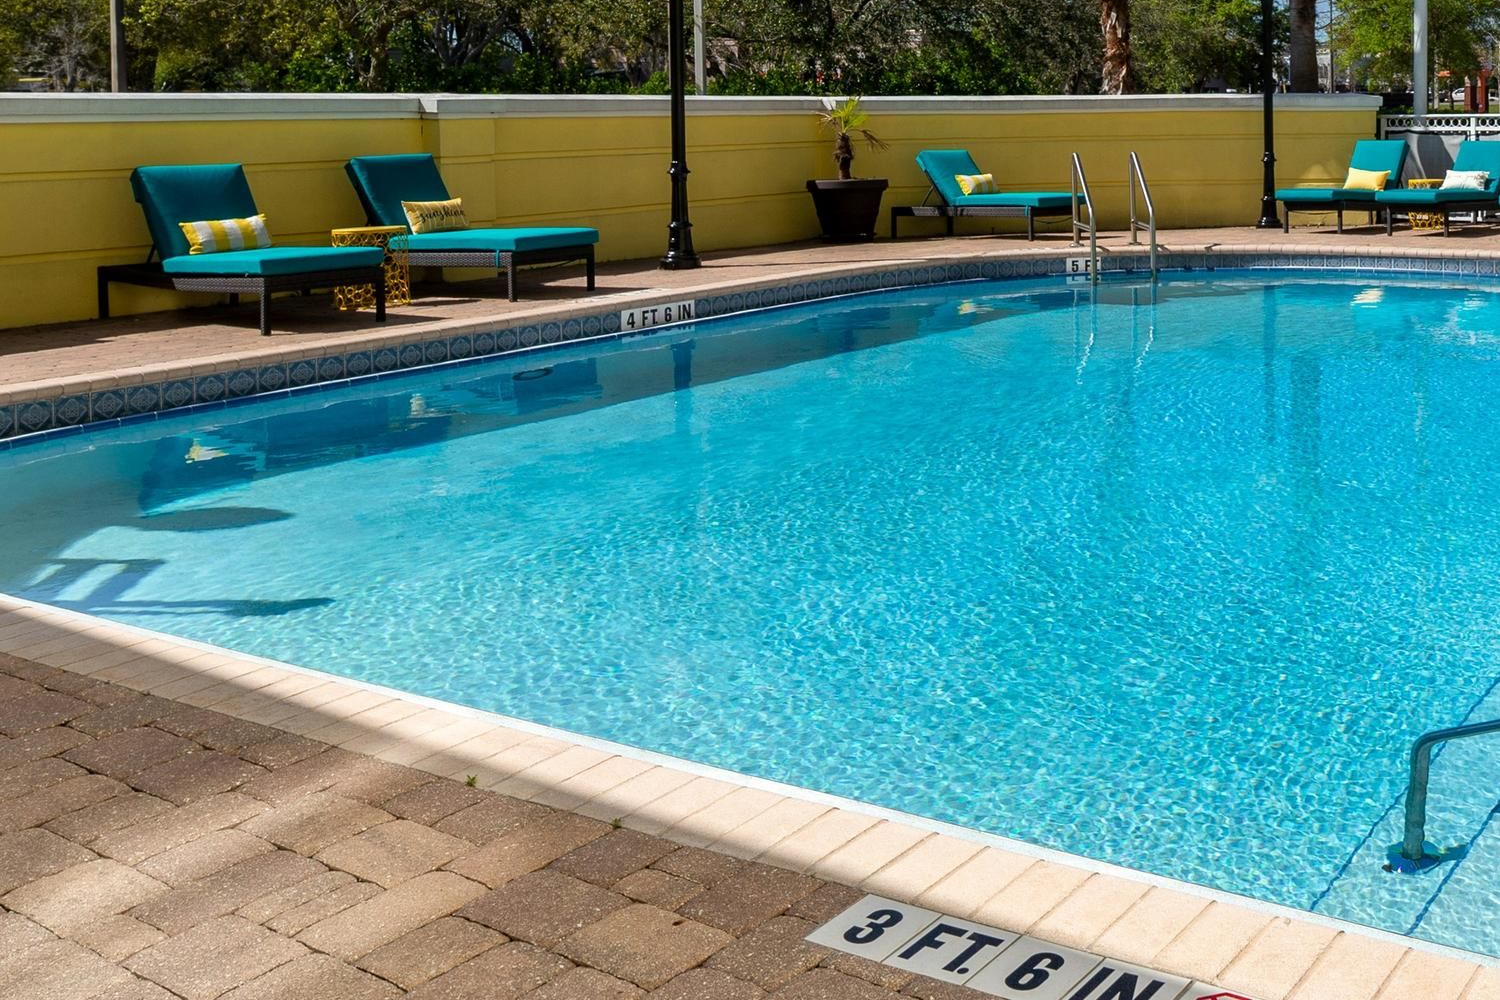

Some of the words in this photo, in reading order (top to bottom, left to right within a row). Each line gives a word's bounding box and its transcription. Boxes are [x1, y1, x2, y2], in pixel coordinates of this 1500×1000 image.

[1072, 260, 1079, 272] 5
[627, 312, 636, 328] 4
[642, 309, 658, 327] FT.
[664, 307, 672, 322] 6
[842, 908, 904, 945] 3
[897, 922, 1005, 975] FT.
[1004, 952, 1065, 991] 6
